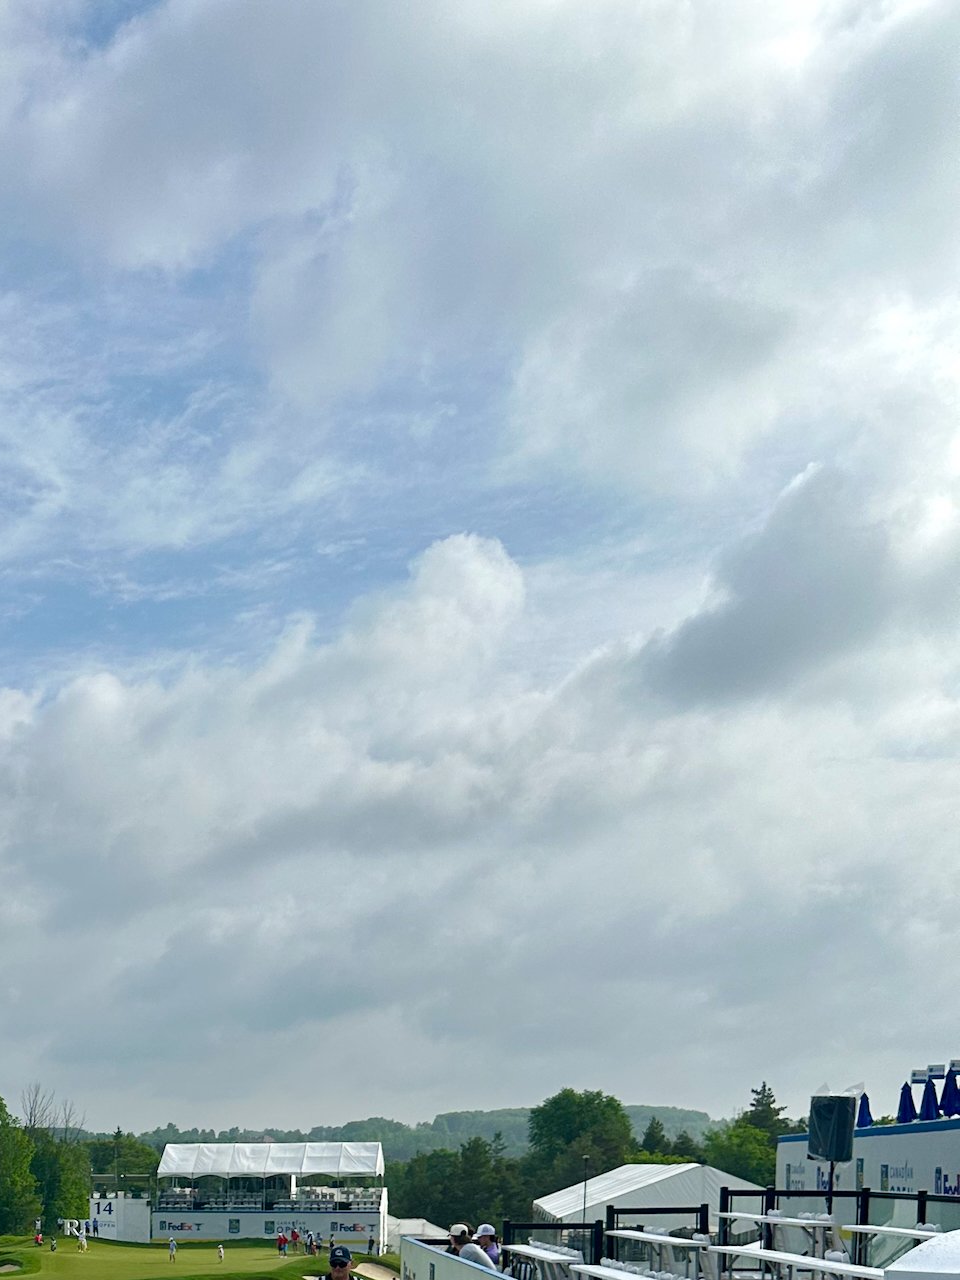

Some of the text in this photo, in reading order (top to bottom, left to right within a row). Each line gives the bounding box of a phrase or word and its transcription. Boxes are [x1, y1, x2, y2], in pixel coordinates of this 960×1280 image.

[94, 1202, 114, 1215] 14
[168, 1223, 192, 1231] FedEx
[340, 1223, 365, 1232] FedEx
